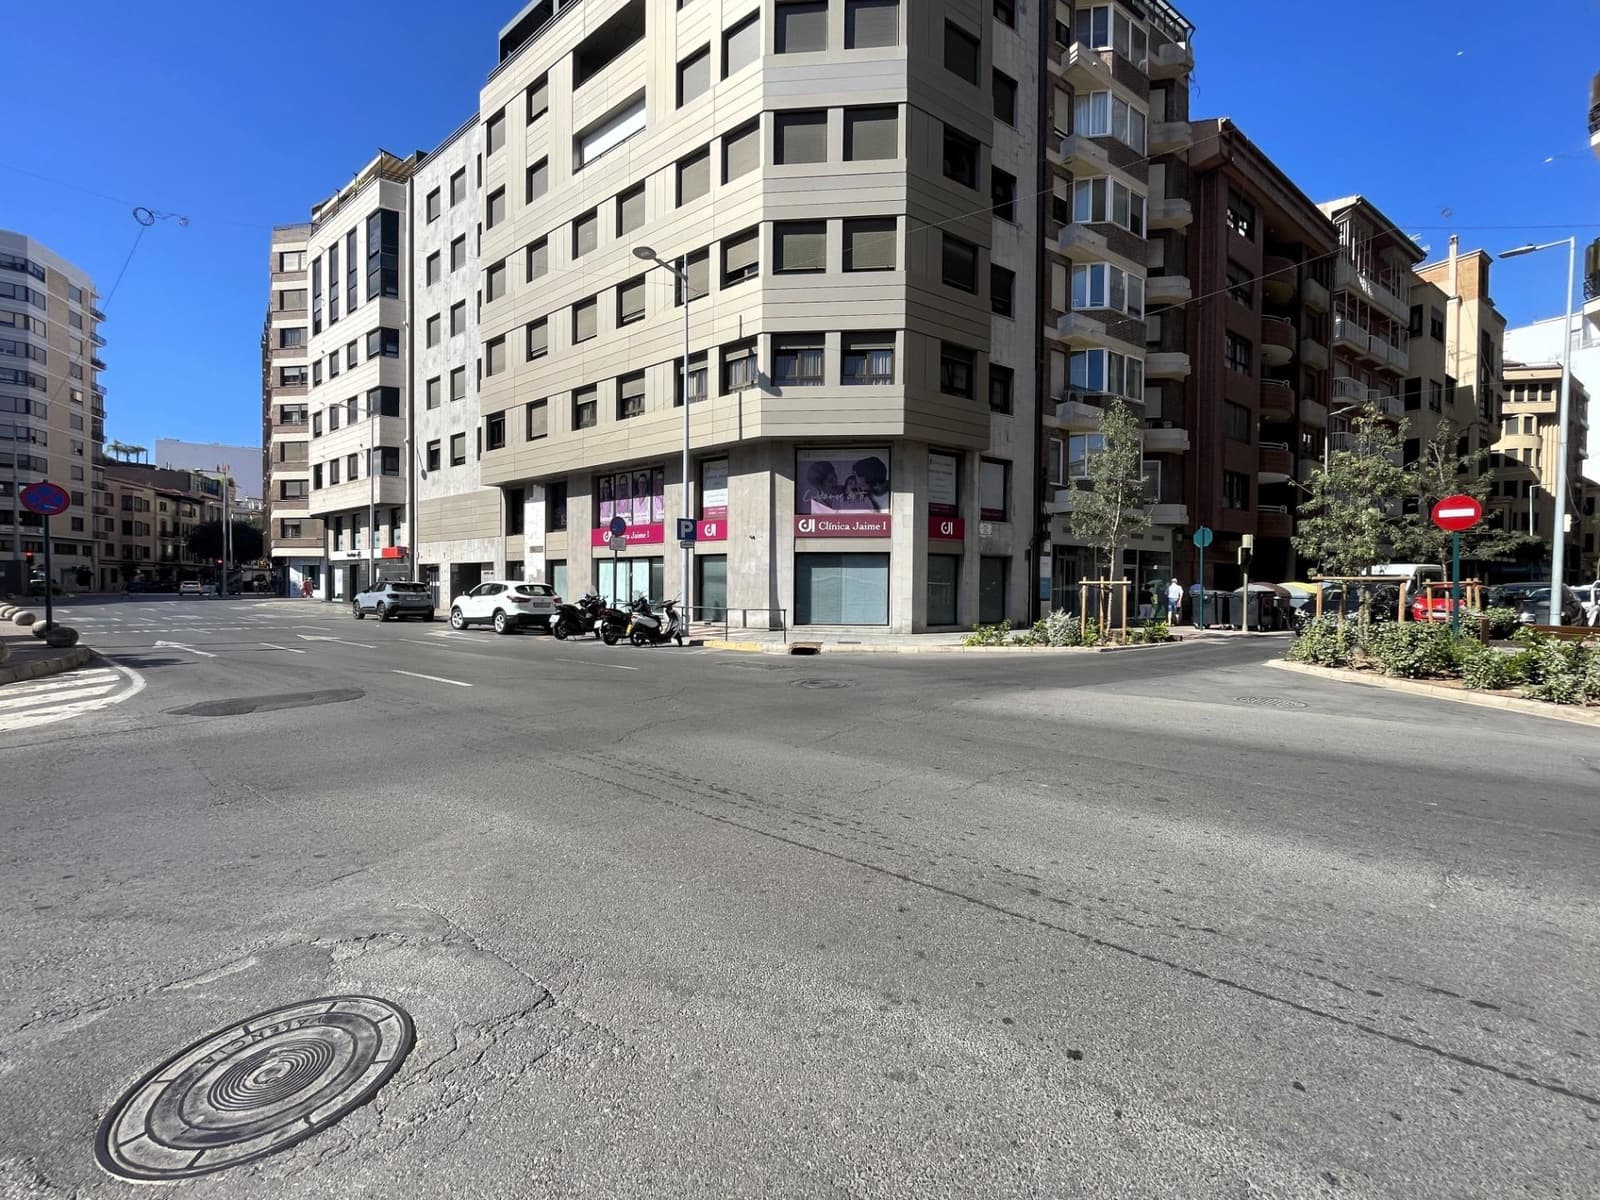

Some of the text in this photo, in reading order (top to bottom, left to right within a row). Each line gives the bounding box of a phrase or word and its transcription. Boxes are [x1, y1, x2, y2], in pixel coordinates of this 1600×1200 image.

[681, 520, 694, 538] P
[818, 520, 850, 531] Clínica
[852, 521, 881, 531] Jaime
[631, 531, 646, 539] Jaime
[199, 1016, 321, 1065] VALENCIA
